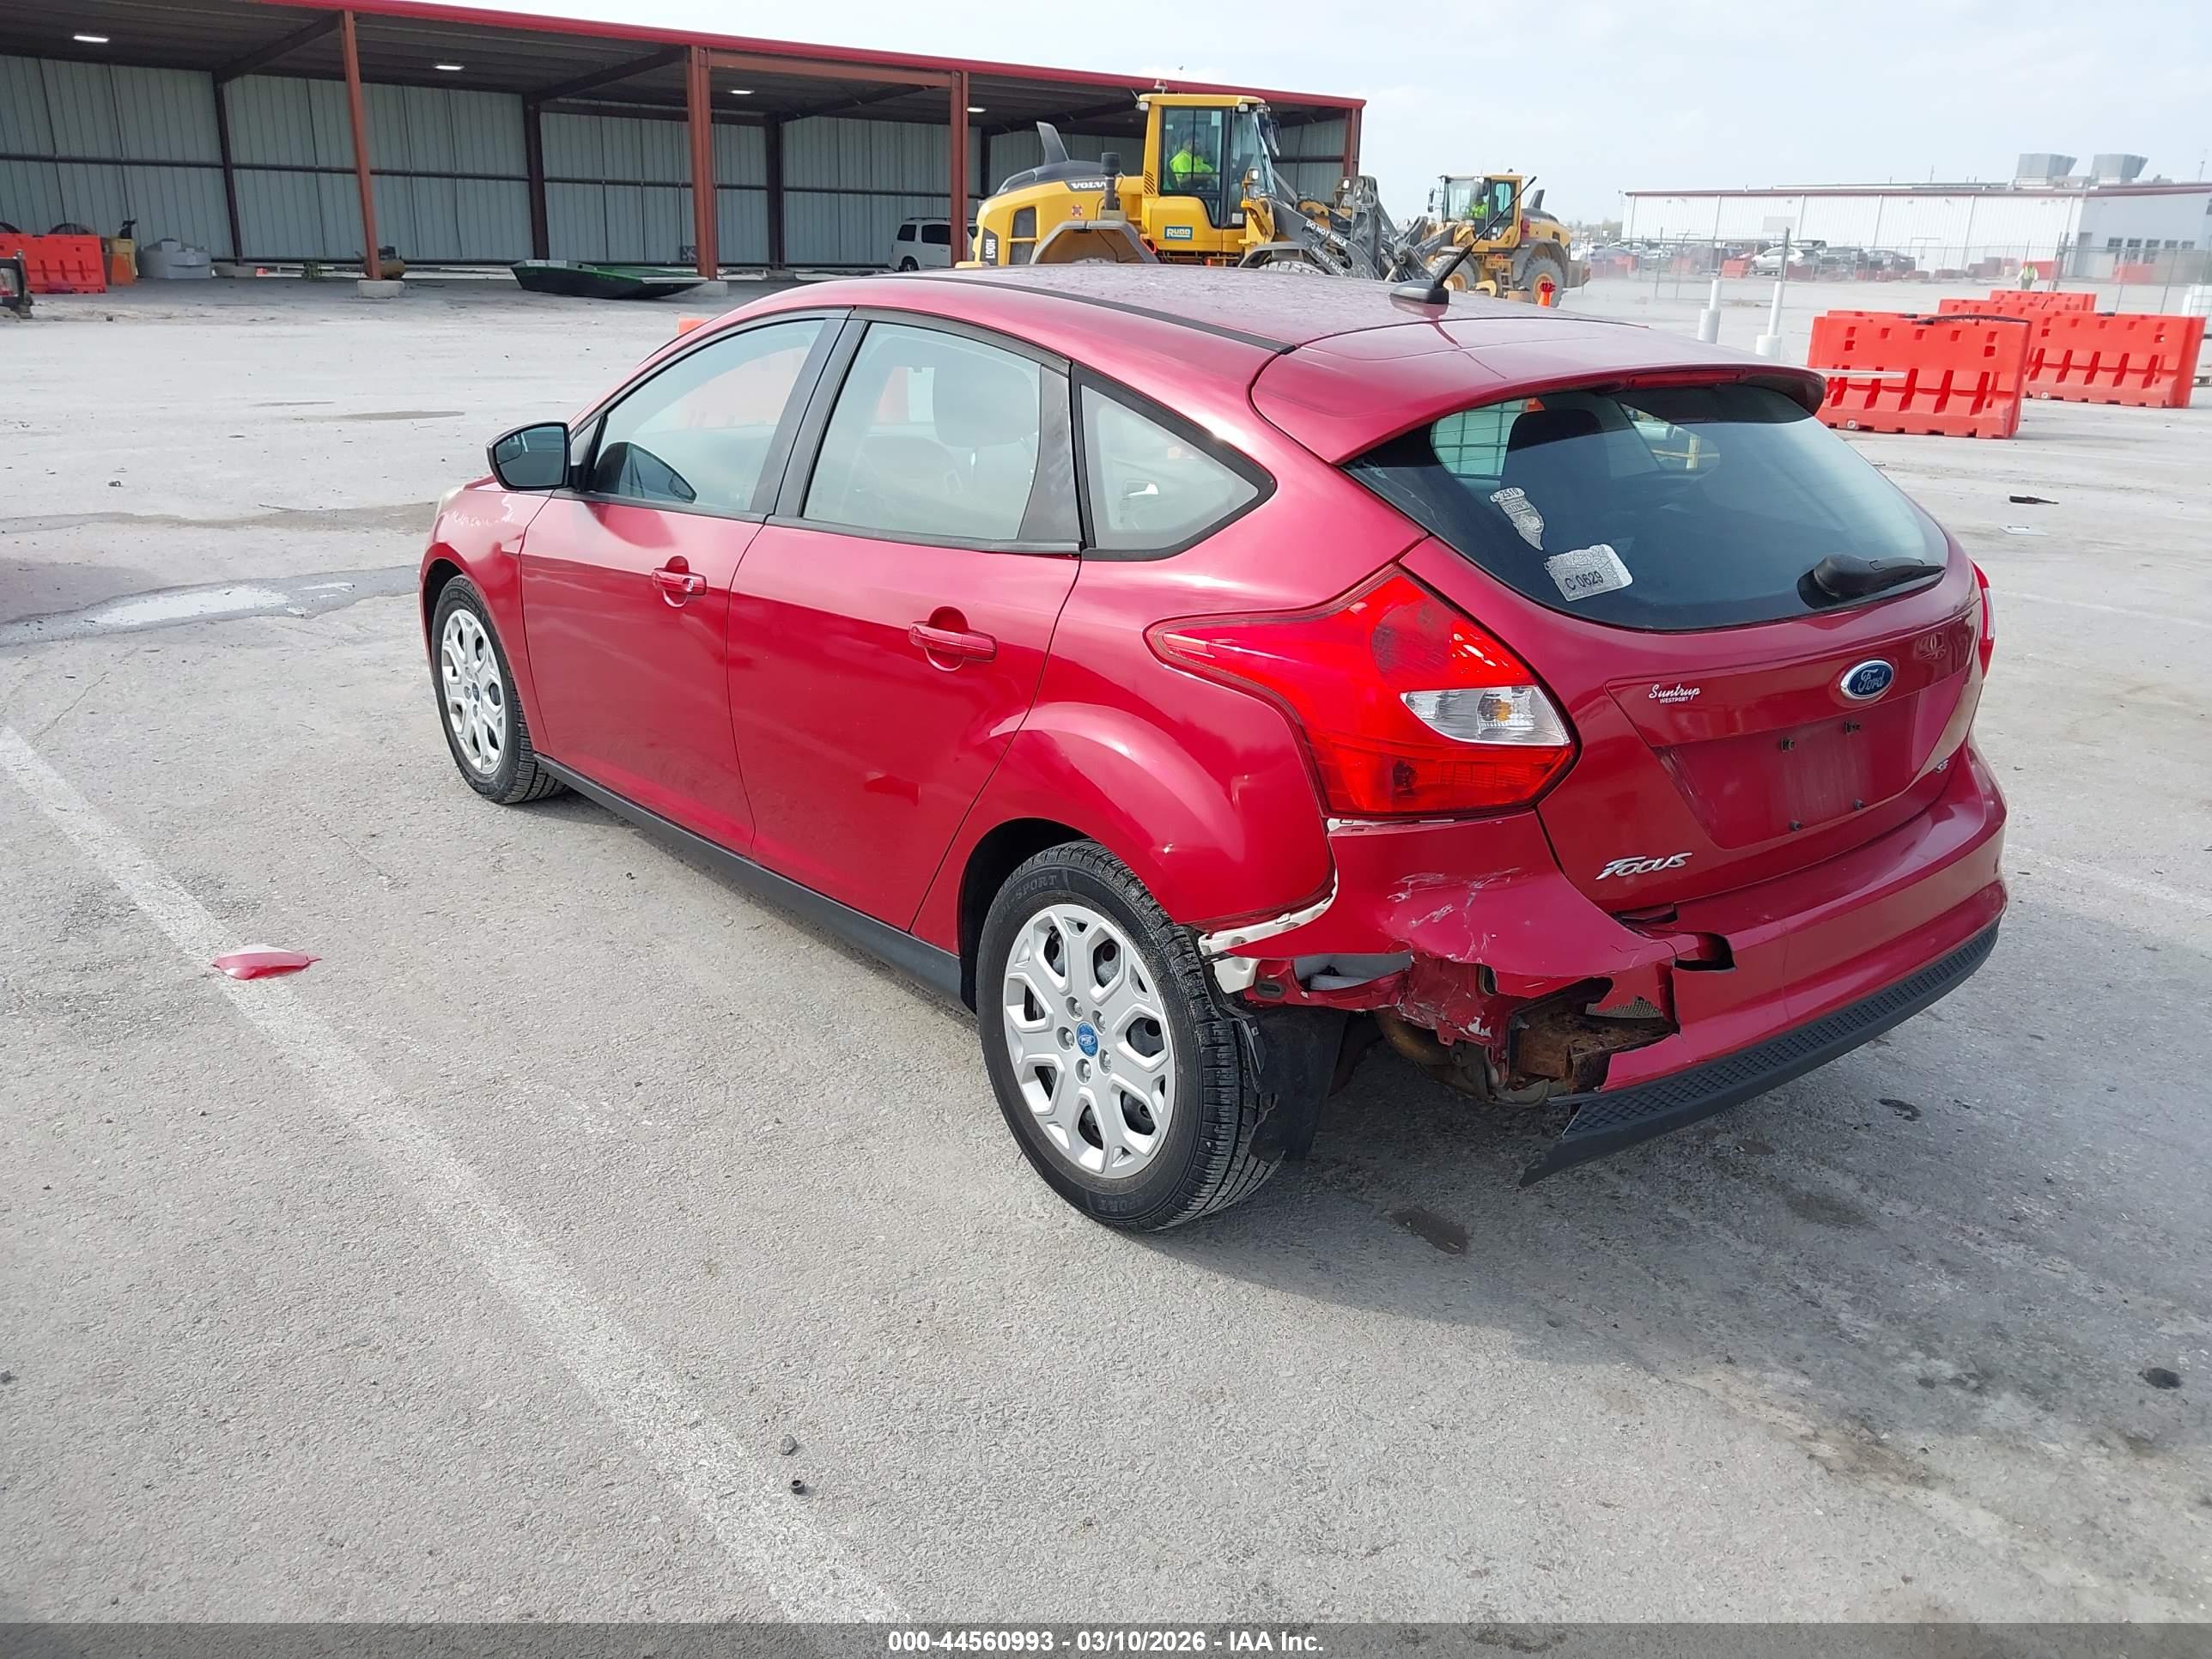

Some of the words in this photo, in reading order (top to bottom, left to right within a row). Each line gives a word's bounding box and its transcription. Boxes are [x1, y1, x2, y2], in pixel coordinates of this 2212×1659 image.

[1306, 220, 1316, 229] DO
[1316, 226, 1330, 238] NOT
[1330, 232, 1347, 248] WALK
[985, 239, 996, 259] L90H
[1565, 578, 1577, 591] C
[1576, 570, 1604, 587] 0629
[1649, 683, 1700, 700] Suntrup
[1857, 669, 1886, 693] Ford
